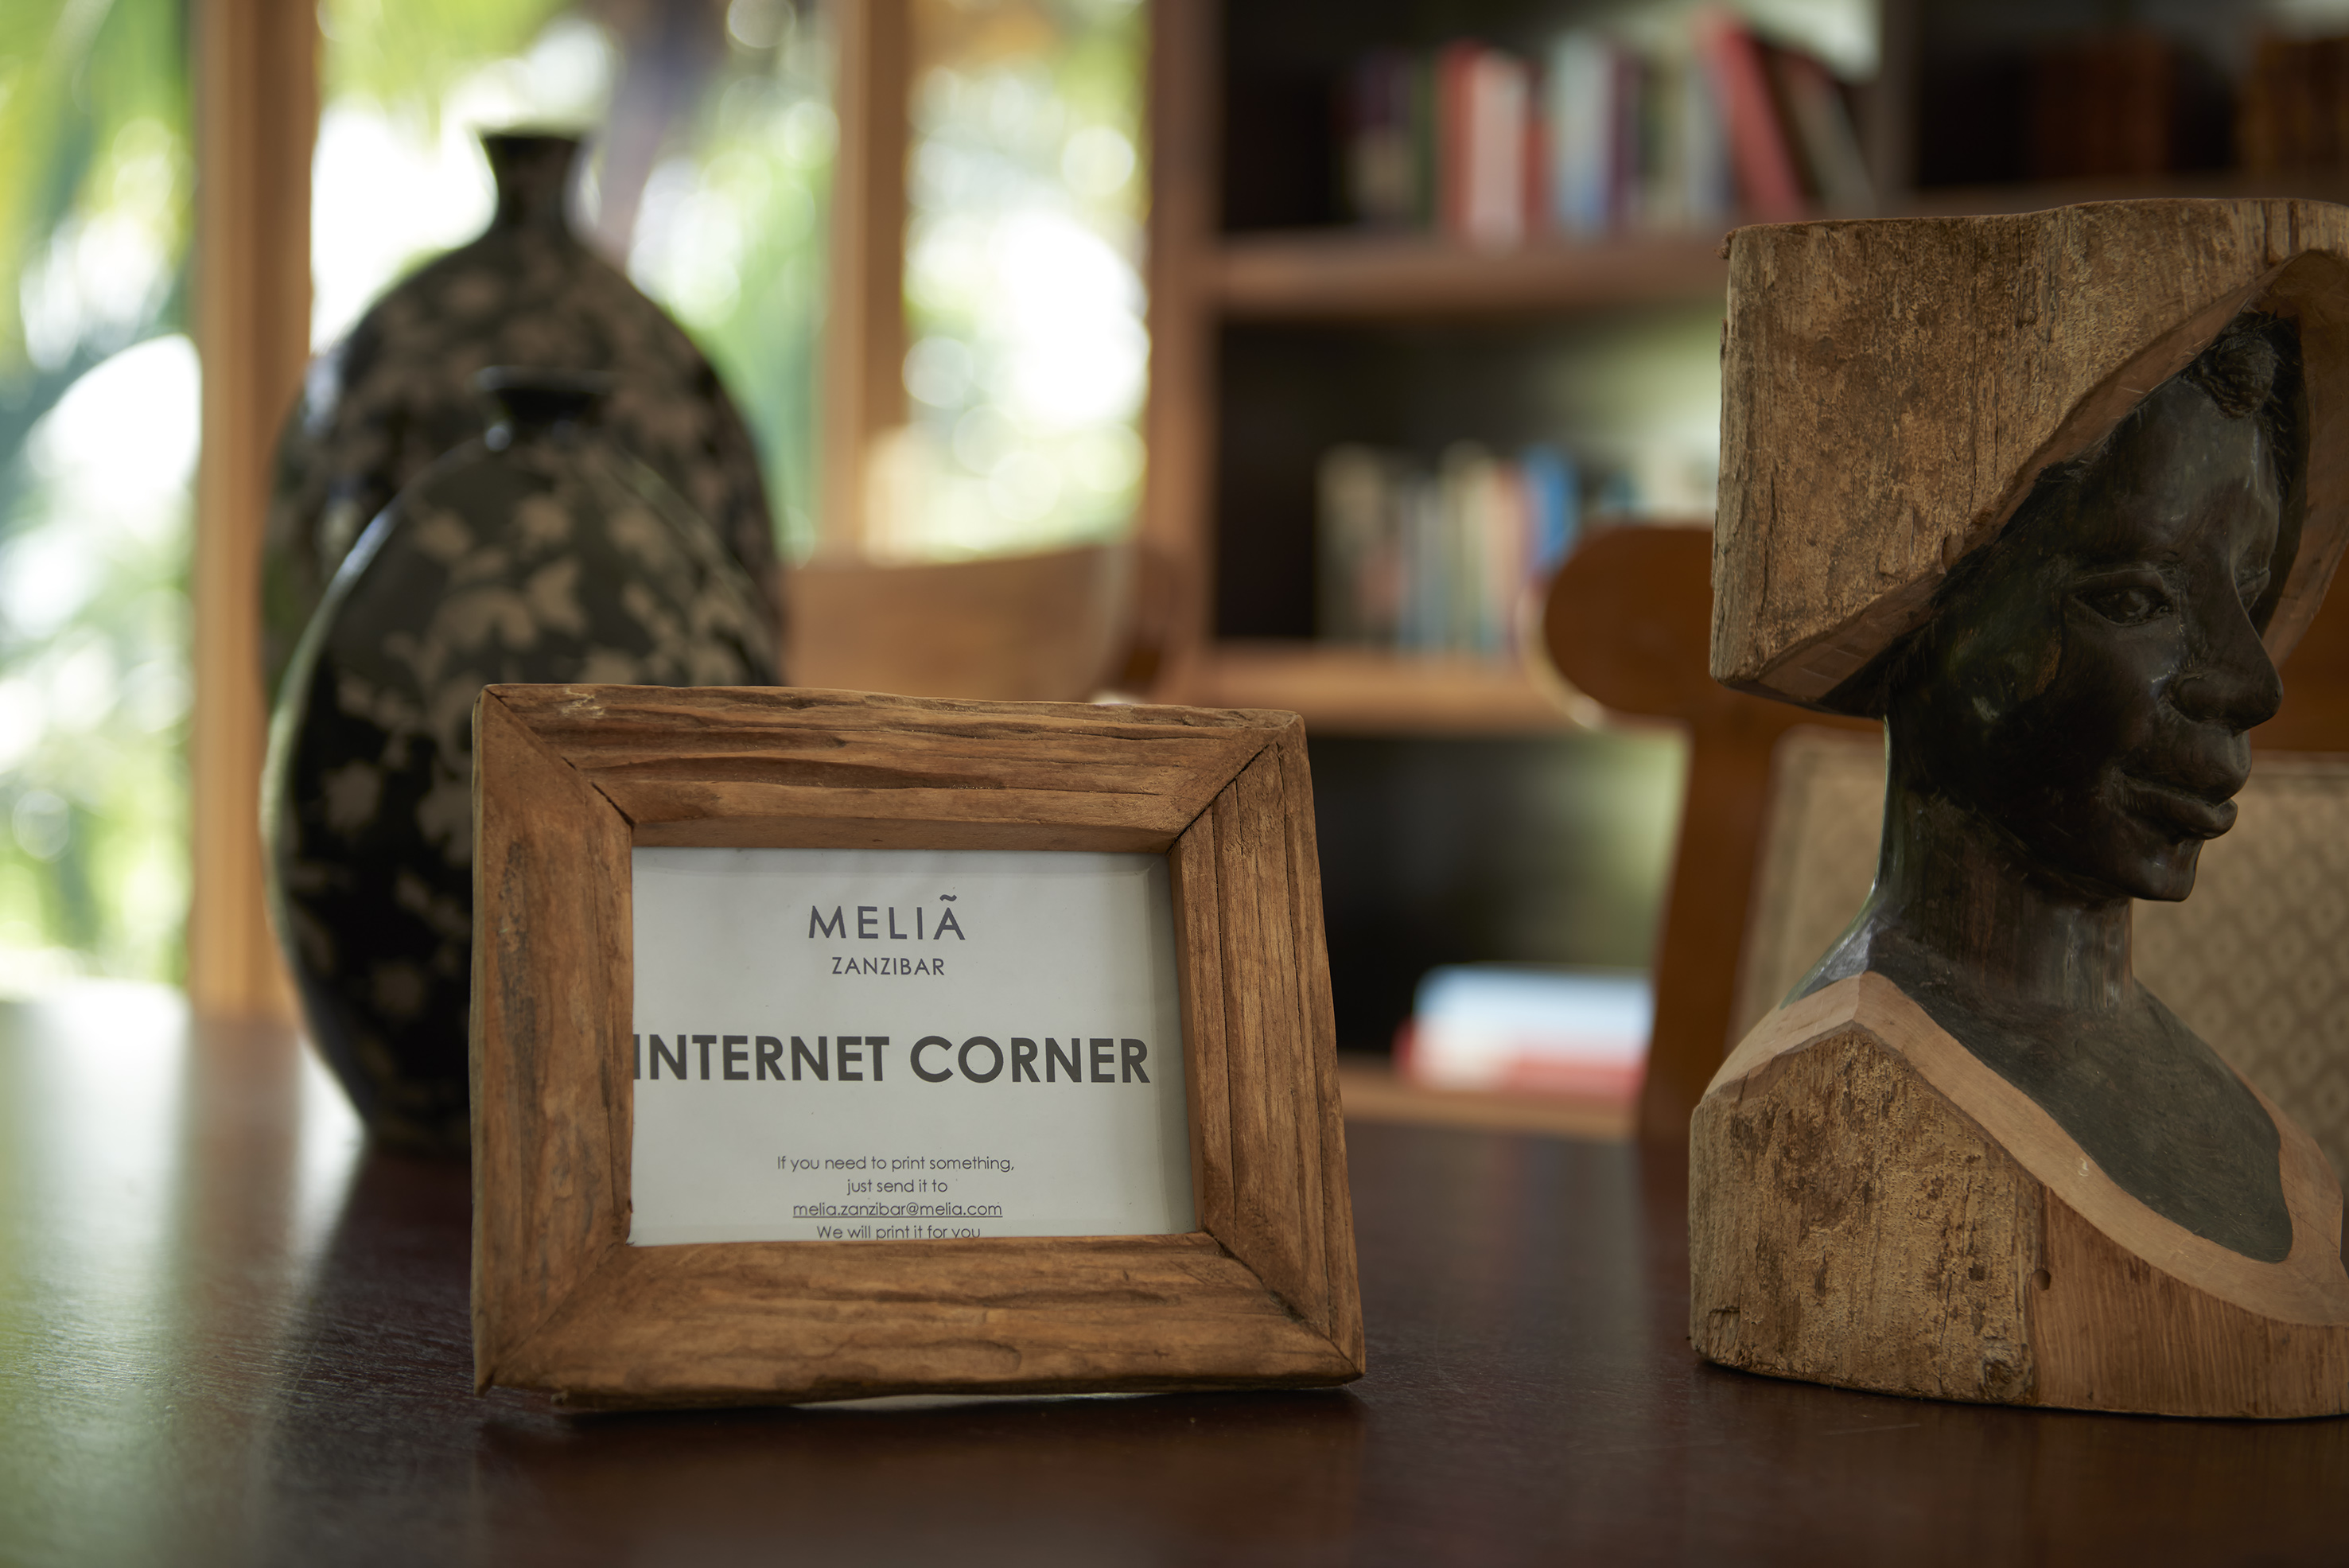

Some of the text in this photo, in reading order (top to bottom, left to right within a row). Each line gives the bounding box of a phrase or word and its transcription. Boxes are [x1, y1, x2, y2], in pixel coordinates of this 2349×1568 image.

[831, 956, 945, 976] ZANZIBAR
[635, 1034, 1150, 1084] INTERNET CORNER
[777, 1155, 1014, 1173] If you need to print something,
[846, 1178, 948, 1196] just send it to
[792, 1201, 1004, 1219] melia.zanzibar@melia.com
[816, 1224, 981, 1240] We will print it for you
